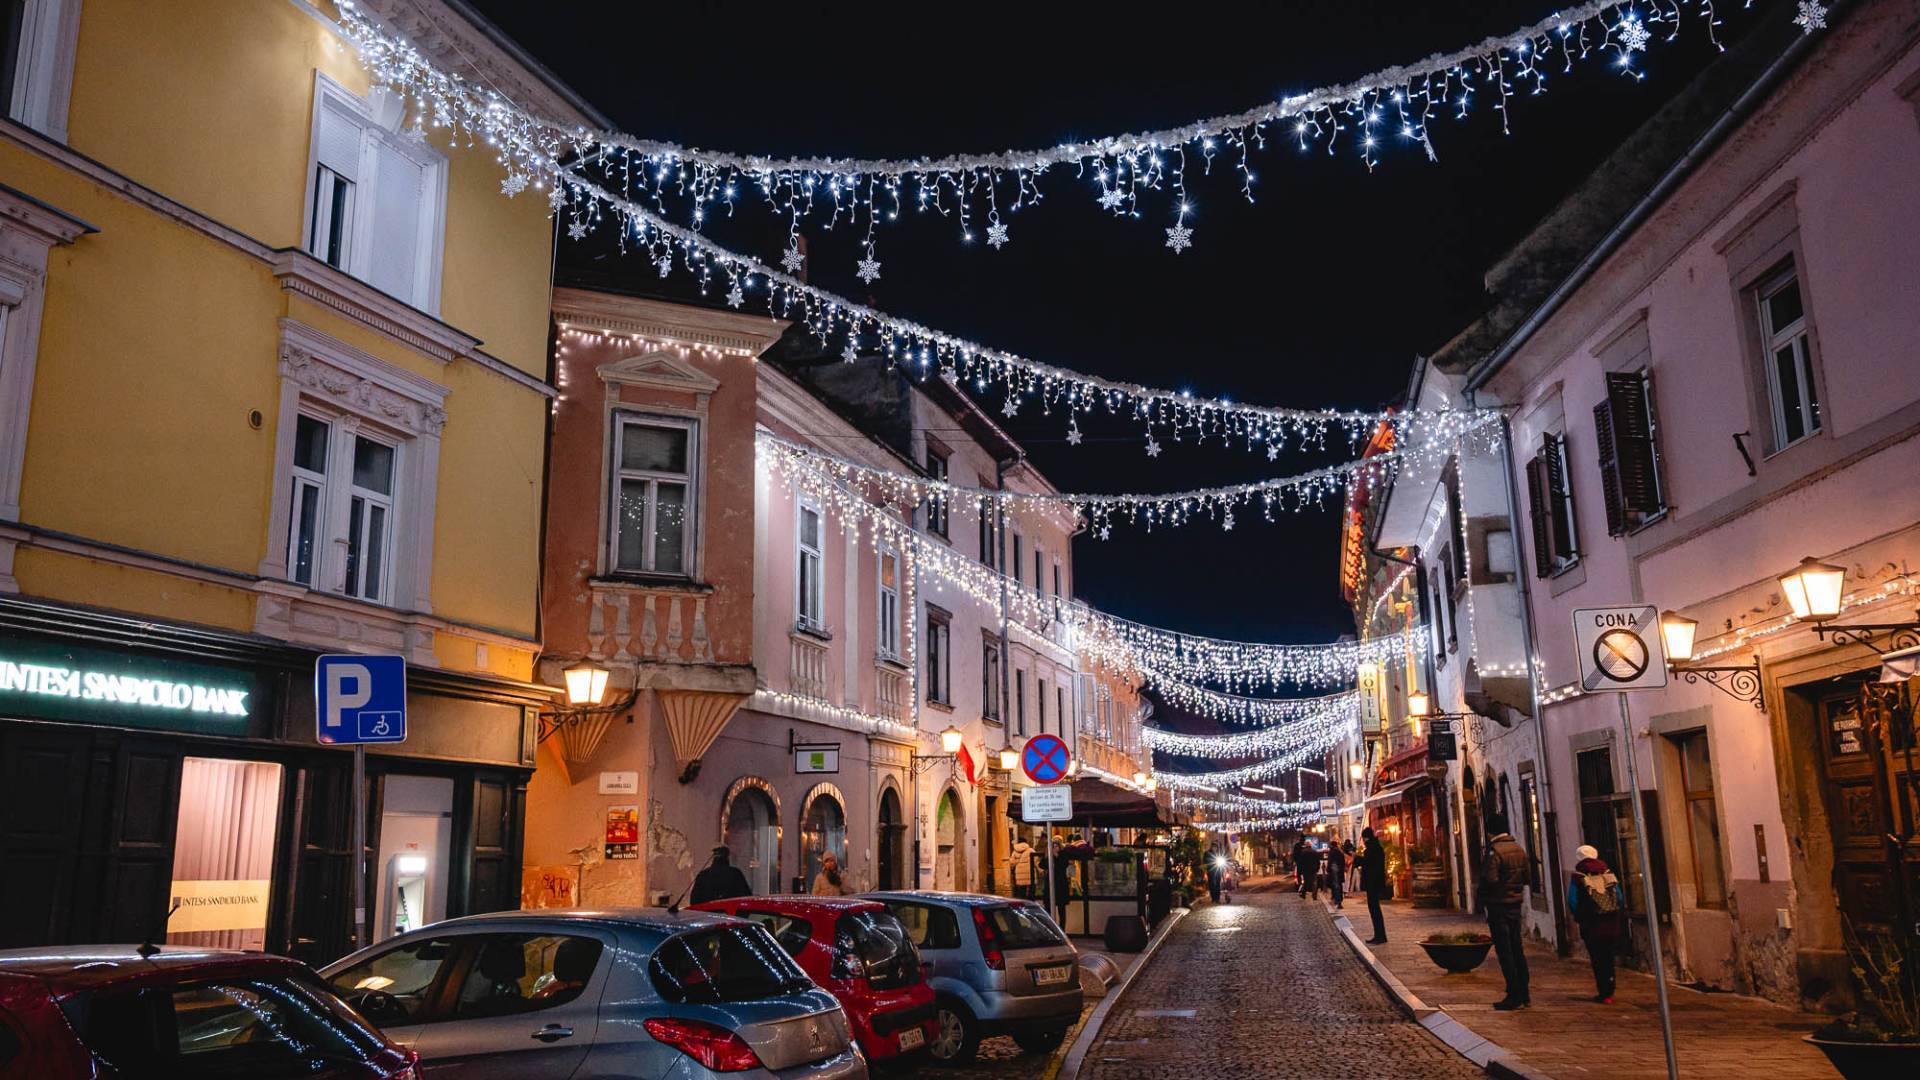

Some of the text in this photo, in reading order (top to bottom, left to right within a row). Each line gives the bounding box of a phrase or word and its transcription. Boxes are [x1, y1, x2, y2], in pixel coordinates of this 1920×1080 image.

[1595, 613, 1637, 627] CONA
[0, 661, 81, 698] INTESA
[192, 685, 249, 716] BANK
[326, 664, 372, 726] P
